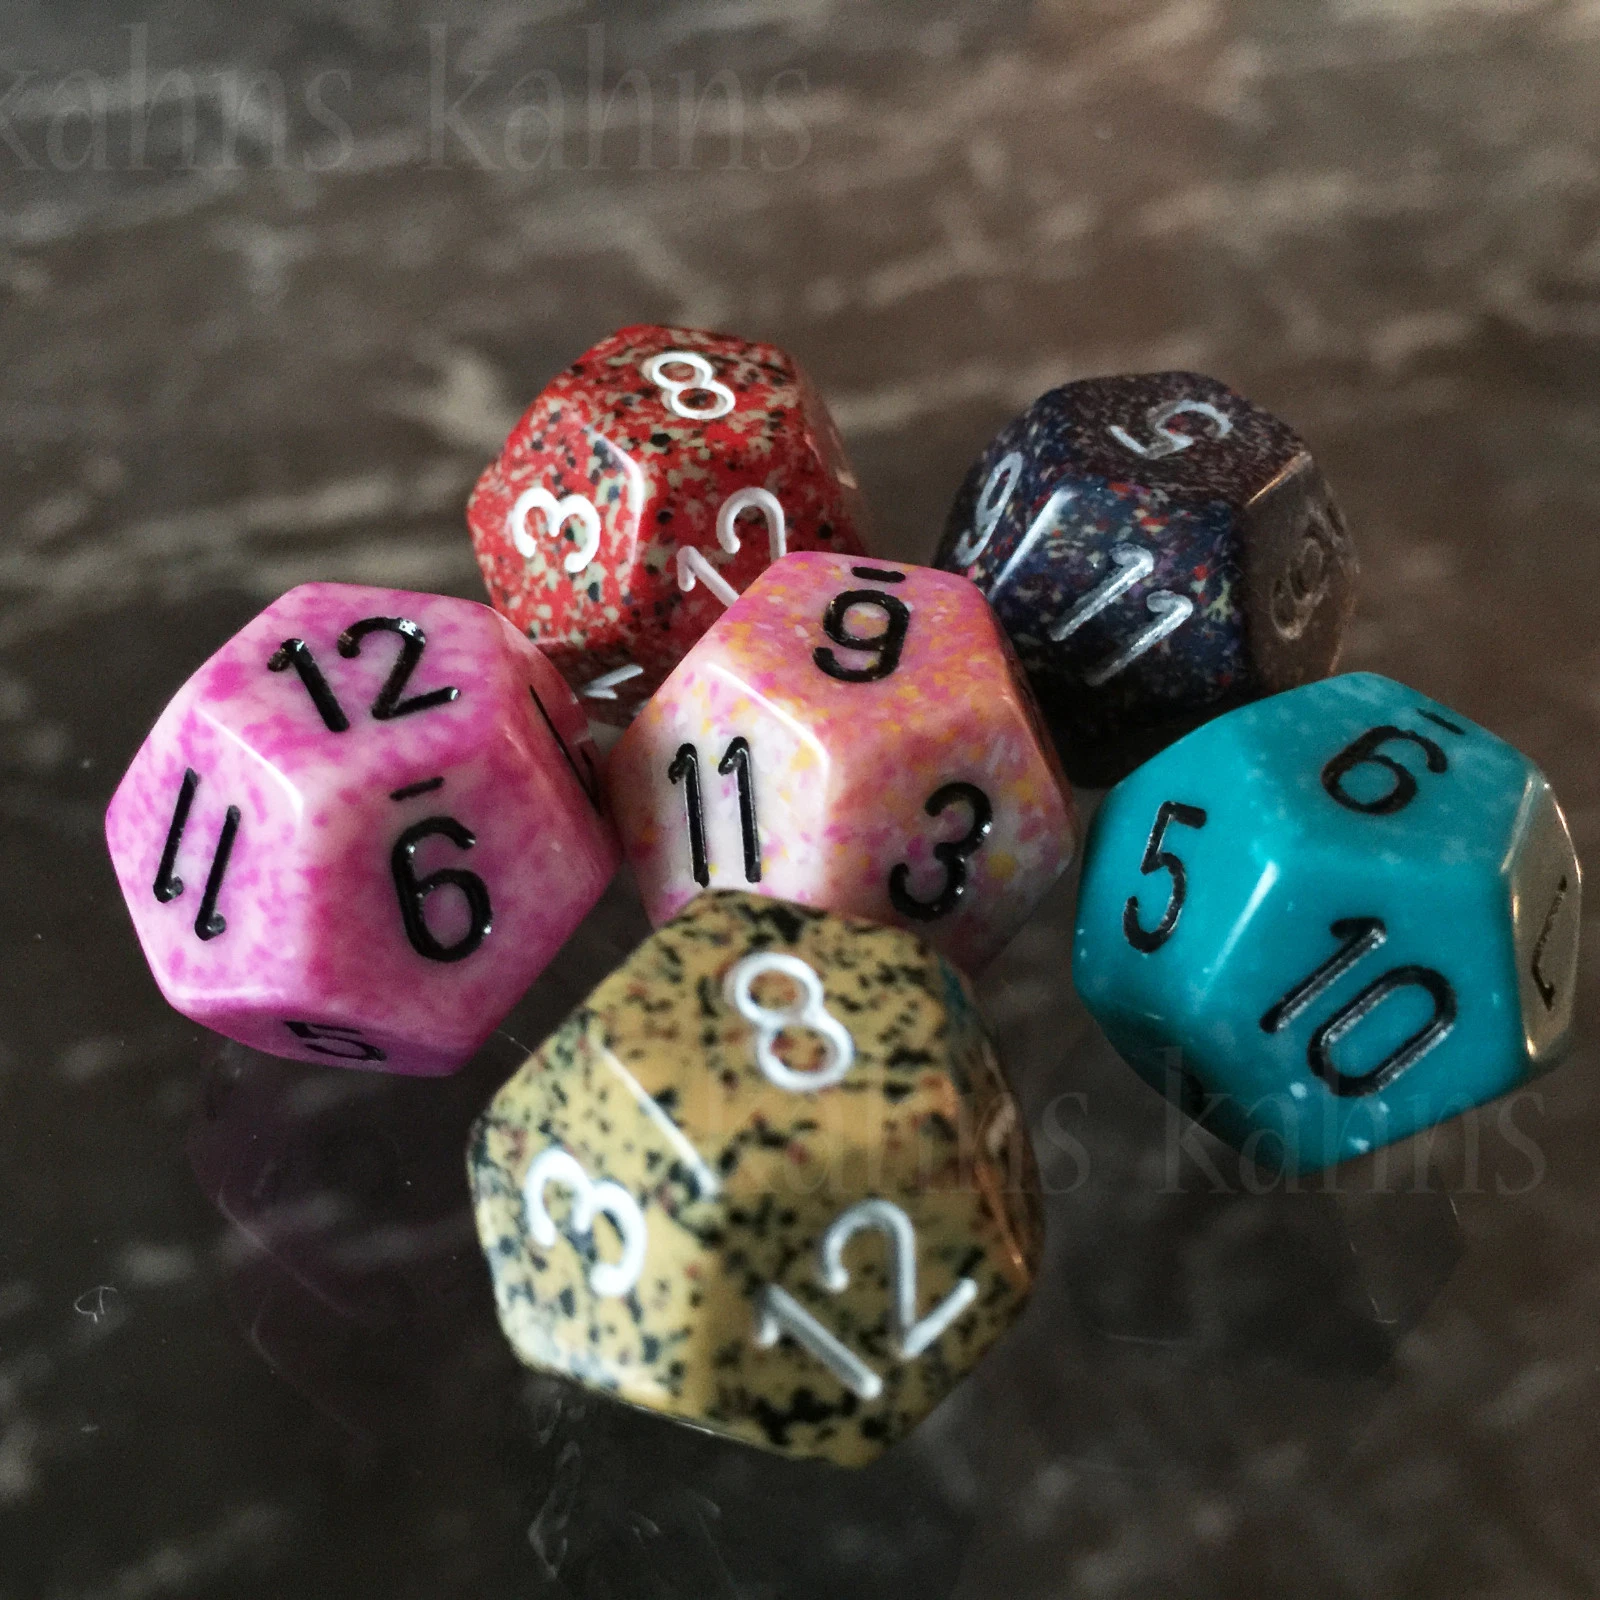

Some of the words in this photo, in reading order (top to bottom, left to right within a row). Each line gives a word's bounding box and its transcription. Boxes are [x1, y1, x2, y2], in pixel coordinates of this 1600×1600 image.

[645, 351, 736, 420] 8
[1109, 400, 1233, 460] 5
[511, 486, 601, 573] 3
[267, 616, 460, 733] 12
[1049, 543, 1194, 686] 11
[153, 767, 241, 941] 11
[668, 736, 762, 887] 11
[888, 781, 993, 921] 3
[1122, 800, 1208, 953] 5
[726, 951, 856, 1091] 8
[1259, 915, 1458, 1097] 10
[523, 1145, 648, 1297] 3
[756, 1199, 979, 1399] 12
